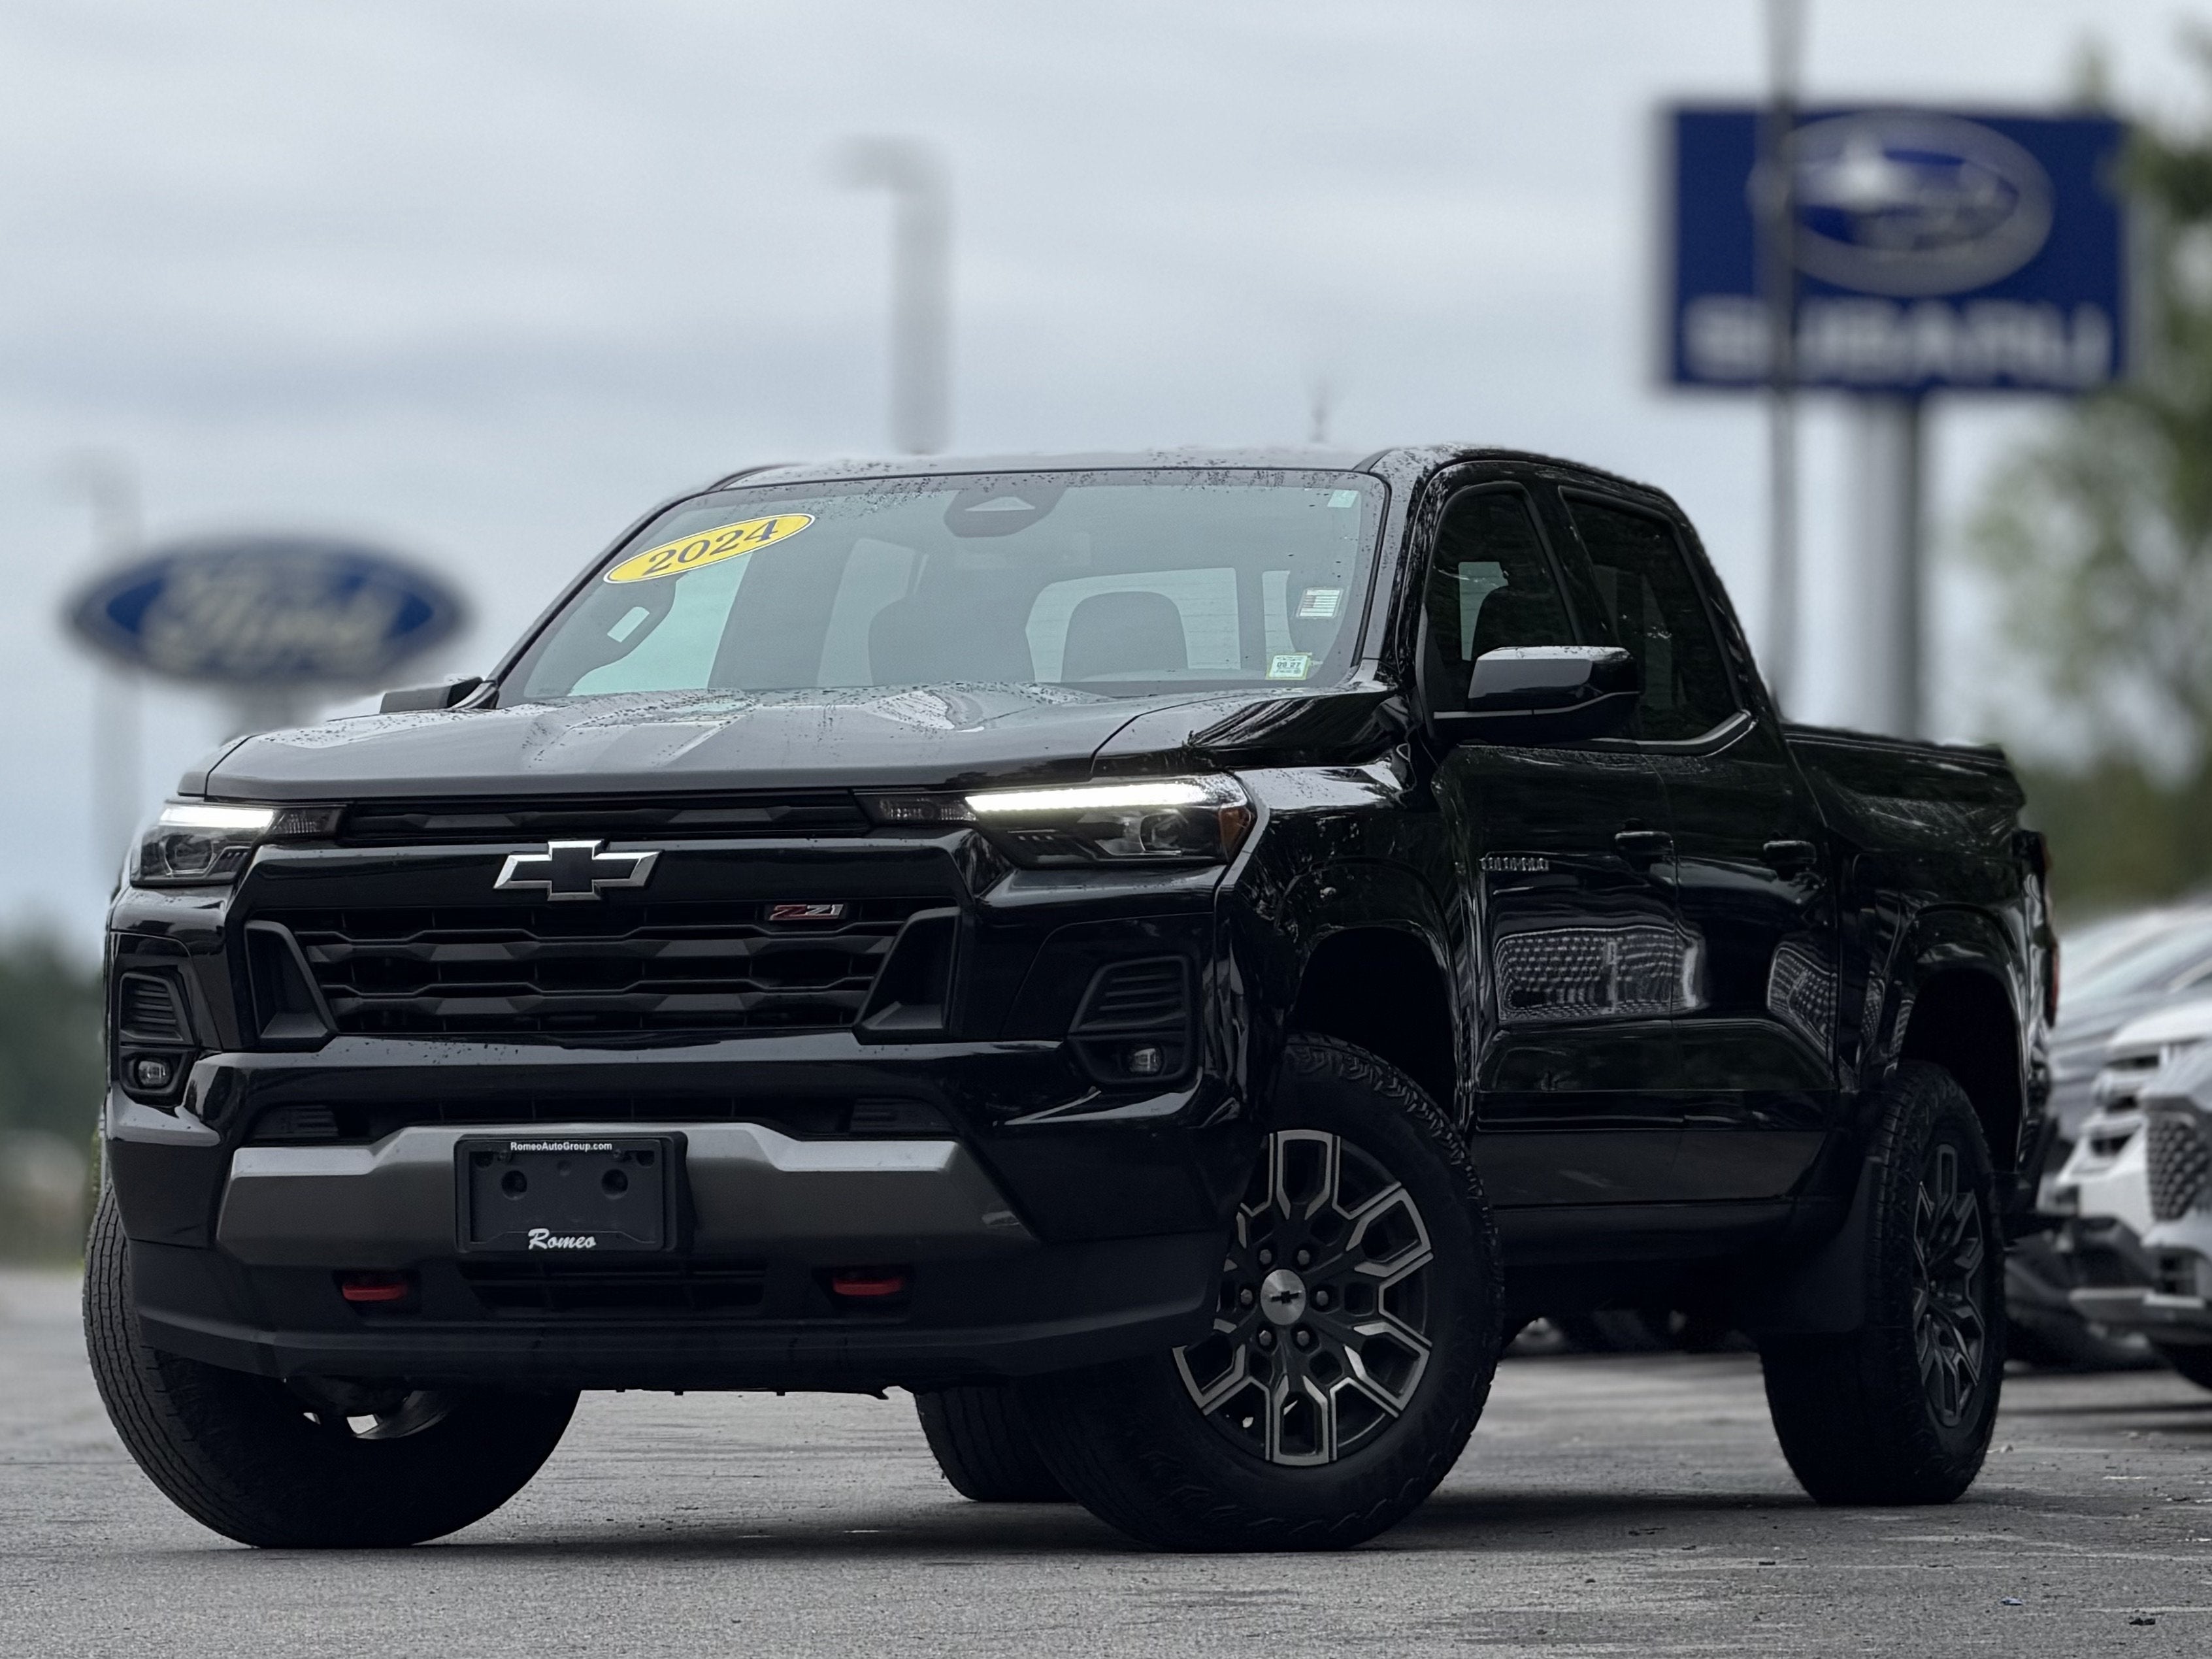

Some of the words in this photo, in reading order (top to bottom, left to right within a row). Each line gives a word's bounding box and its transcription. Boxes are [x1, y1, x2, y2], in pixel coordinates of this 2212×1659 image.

[641, 519, 779, 576] 2024
[510, 1142, 612, 1153] RomeoAutoGroup.com
[528, 1228, 597, 1250] Romeo
